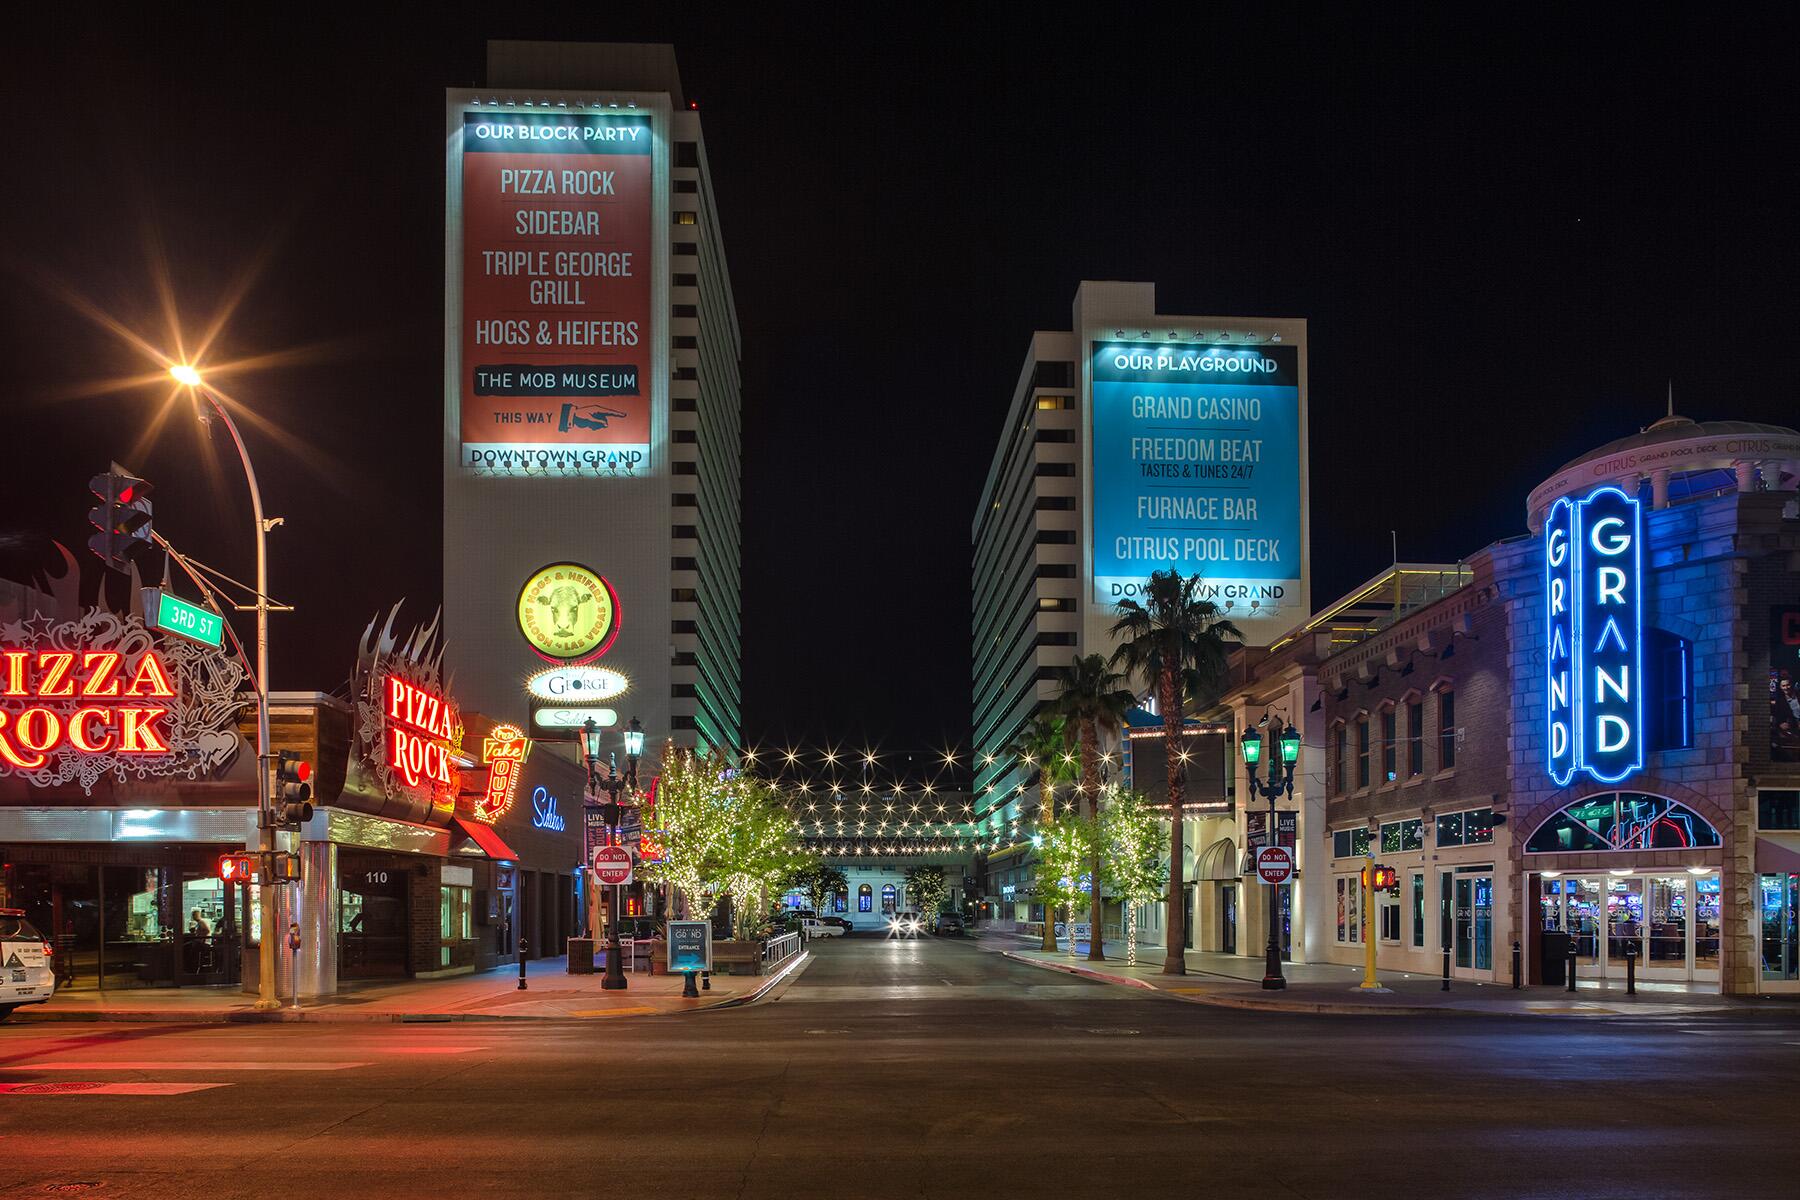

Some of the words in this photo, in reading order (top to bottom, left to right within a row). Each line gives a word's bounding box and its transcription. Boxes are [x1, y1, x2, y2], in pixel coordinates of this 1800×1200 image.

[475, 125, 514, 140] OUR
[519, 125, 579, 141] BLOCK
[584, 127, 641, 141] PARTY
[501, 169, 556, 194] PIZZA
[562, 170, 615, 195] ROCK
[515, 210, 600, 236] SIDEBAR
[482, 250, 550, 276] TRIPLE
[555, 251, 633, 277] GEORGE
[529, 279, 586, 305] GRILL
[475, 319, 530, 345] HOGS
[535, 320, 553, 346] &
[557, 320, 639, 346] HEIFERS
[1114, 354, 1153, 370] OUR
[1157, 356, 1278, 373] PLAYGROUND
[478, 372, 513, 388] THE
[519, 372, 556, 388] MOB
[562, 372, 637, 389] MUSEUM
[494, 411, 522, 424] THIS
[526, 411, 553, 424] WAY
[1132, 395, 1192, 419] GRAND
[1197, 397, 1261, 421] CASINO
[471, 449, 578, 463] DOWNTOWN
[582, 449, 642, 464] GRAND
[1131, 437, 1215, 462] FREEDOM
[1220, 439, 1263, 462] BEAT
[1726, 440, 1770, 453] CITRUS
[1140, 463, 1179, 478] TASTES
[1182, 464, 1192, 478] &
[1194, 464, 1228, 479] TUNES
[1231, 465, 1254, 479] 24/7
[1593, 456, 1637, 476] CITRUS
[1640, 451, 1669, 464] GRAND
[1670, 448, 1694, 458] POOL
[1696, 445, 1718, 455] DECK
[1137, 496, 1218, 520] FURNACE
[1223, 498, 1258, 521] BAR
[1115, 536, 1179, 561] CITRUS
[1184, 538, 1230, 561] POOL
[1234, 539, 1280, 562] DECK
[527, 576, 552, 604] HOGS
[555, 572, 564, 580] &
[568, 572, 604, 603] HEIFERS
[1111, 583, 1220, 598] DOWWN
[1223, 585, 1284, 599] GRAND
[171, 606, 196, 628] 3RD
[199, 617, 214, 636] ST
[564, 638, 585, 651] LAS
[585, 606, 607, 640] VEGAS
[1549, 528, 1569, 760] GRAND
[1590, 517, 1632, 753] GRAND
[3, 652, 174, 697] IZZA
[391, 677, 453, 741] PIZZA
[394, 728, 451, 787] ROCK
[486, 742, 521, 757] Take
[491, 760, 510, 806] OUT
[366, 871, 388, 884] 110
[1652, 909, 1684, 917] GRND
[675, 931, 702, 939] GRND
